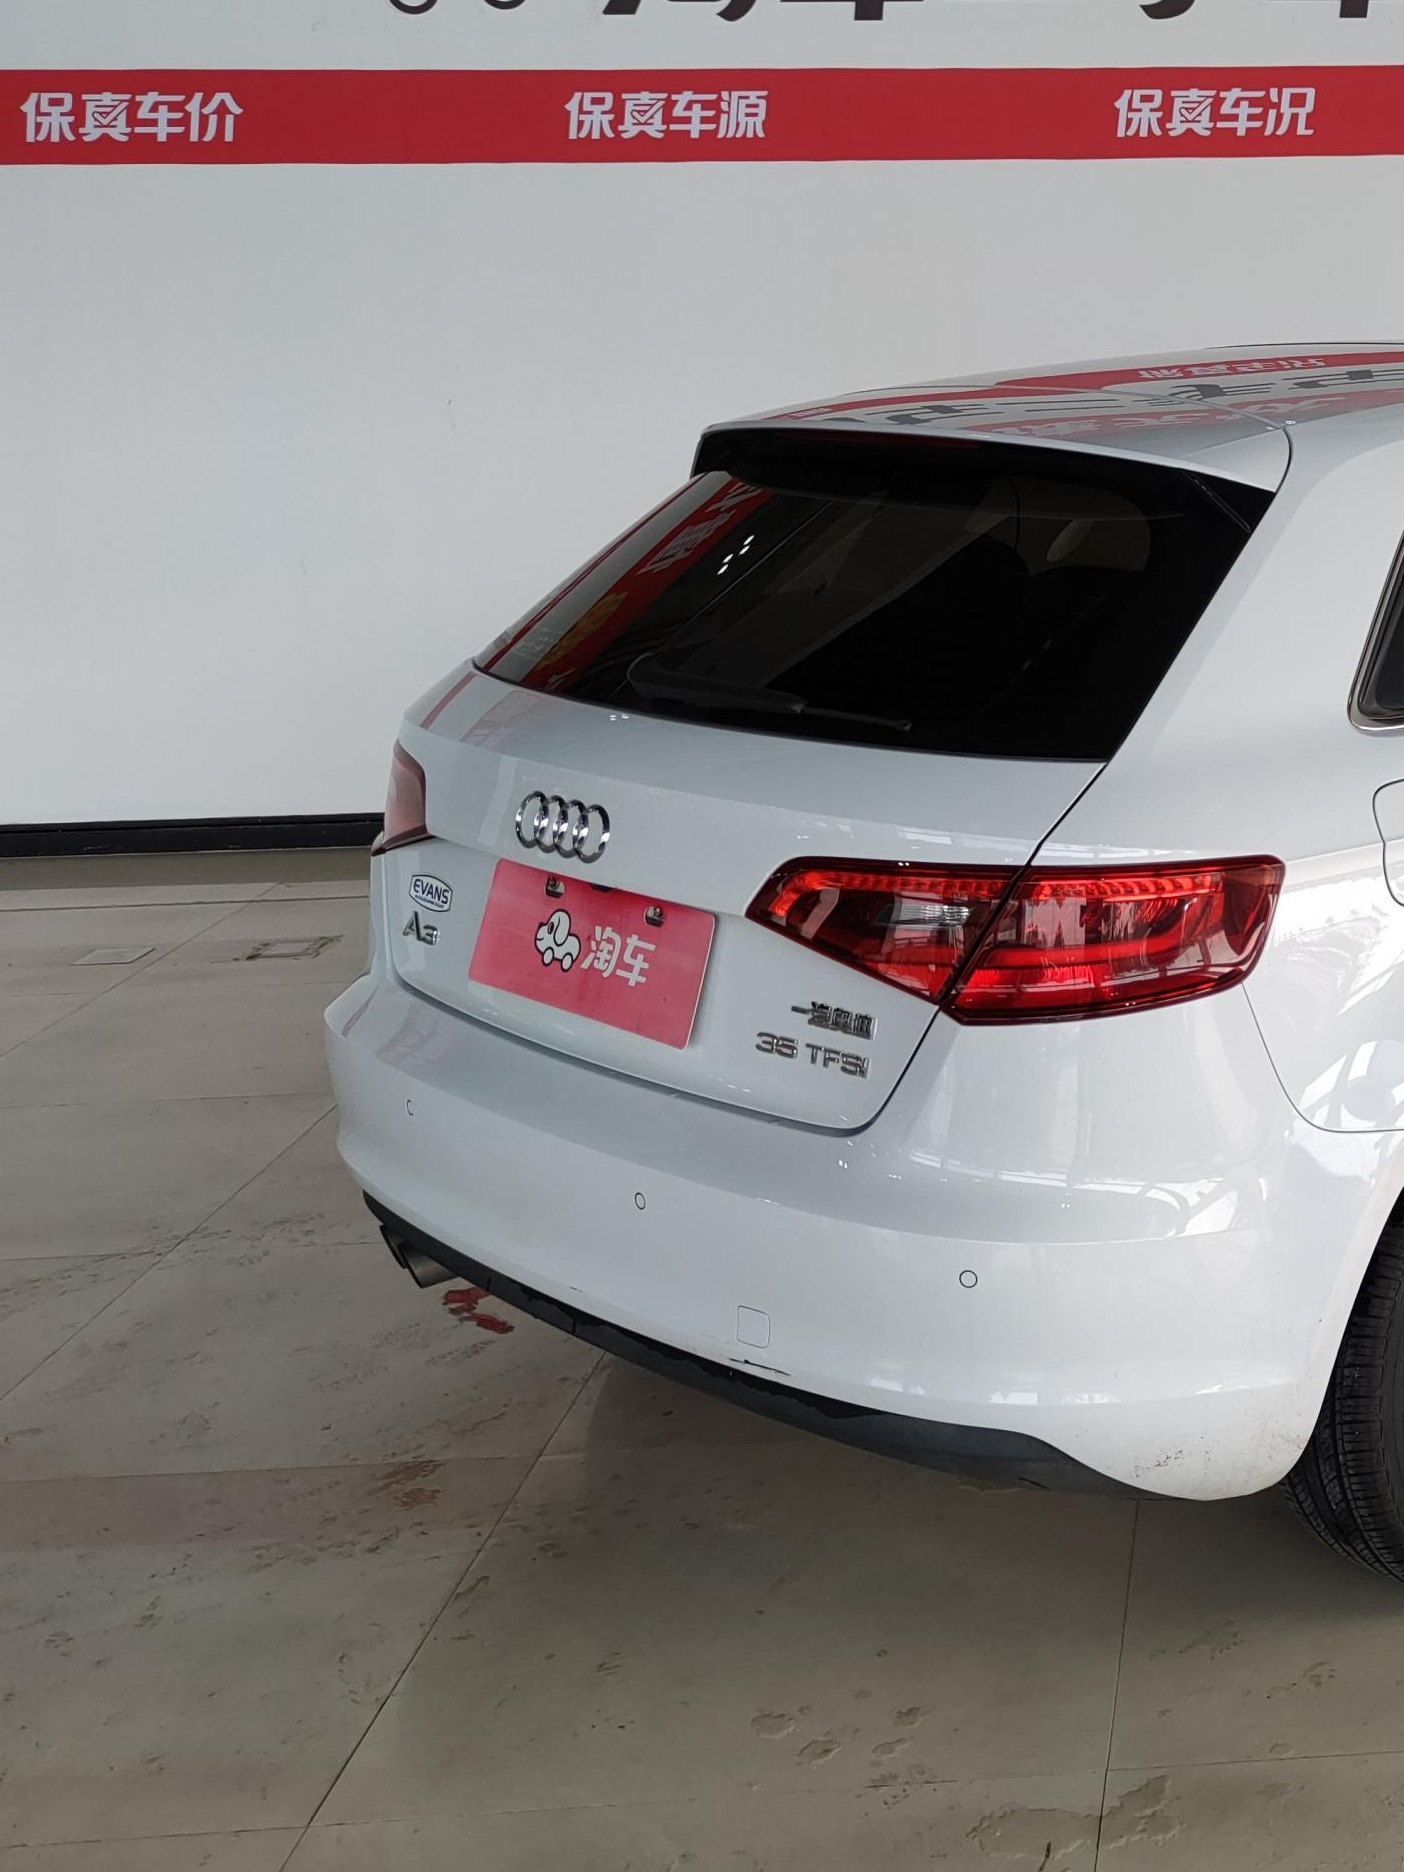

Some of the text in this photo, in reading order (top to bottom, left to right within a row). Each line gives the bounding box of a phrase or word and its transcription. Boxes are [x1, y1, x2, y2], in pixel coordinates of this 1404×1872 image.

[20, 92, 243, 142] 保真车价
[565, 91, 768, 139] 保真车源
[1114, 88, 1315, 137] 保真车况
[413, 878, 450, 905] EVANS
[402, 910, 439, 945] A3
[580, 926, 656, 987] 淘车
[756, 1032, 798, 1059] 35
